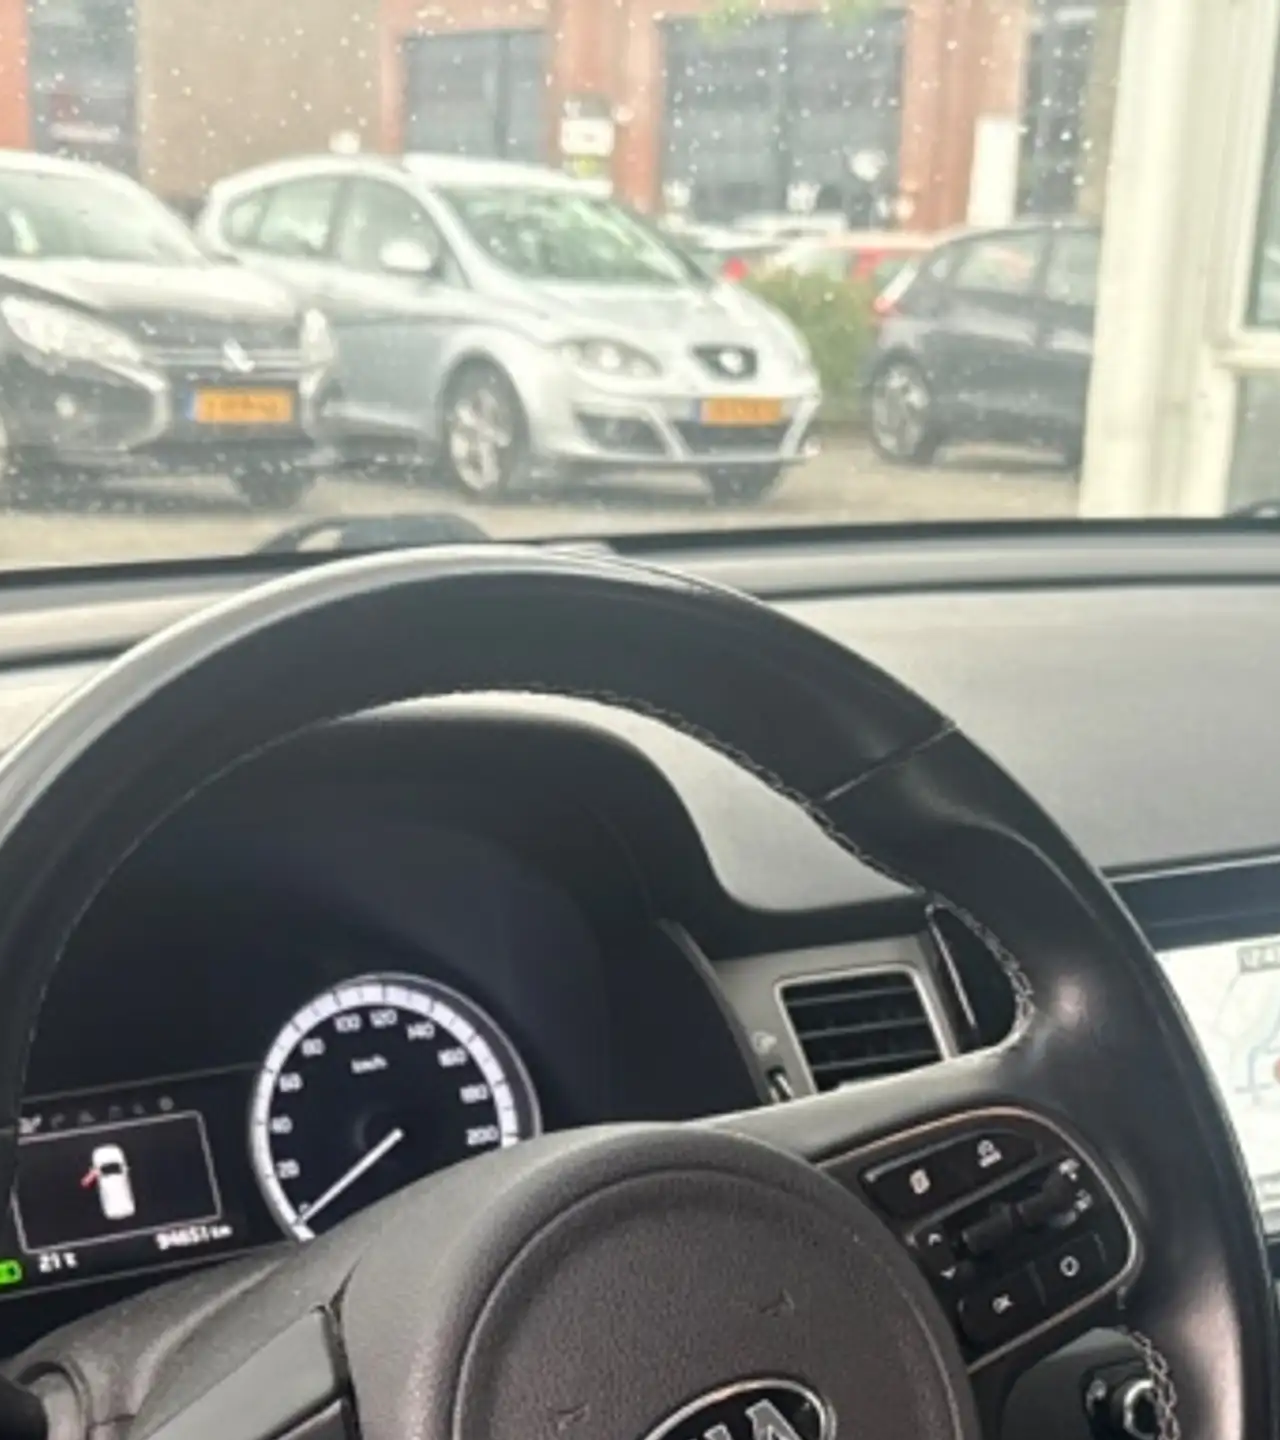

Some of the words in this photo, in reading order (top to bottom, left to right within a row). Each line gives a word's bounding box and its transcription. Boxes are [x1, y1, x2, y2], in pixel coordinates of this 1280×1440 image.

[370, 1009, 398, 1028] 120
[406, 1022, 435, 1041] 140
[466, 1125, 499, 1146] 200
[276, 1159, 300, 1179] 20
